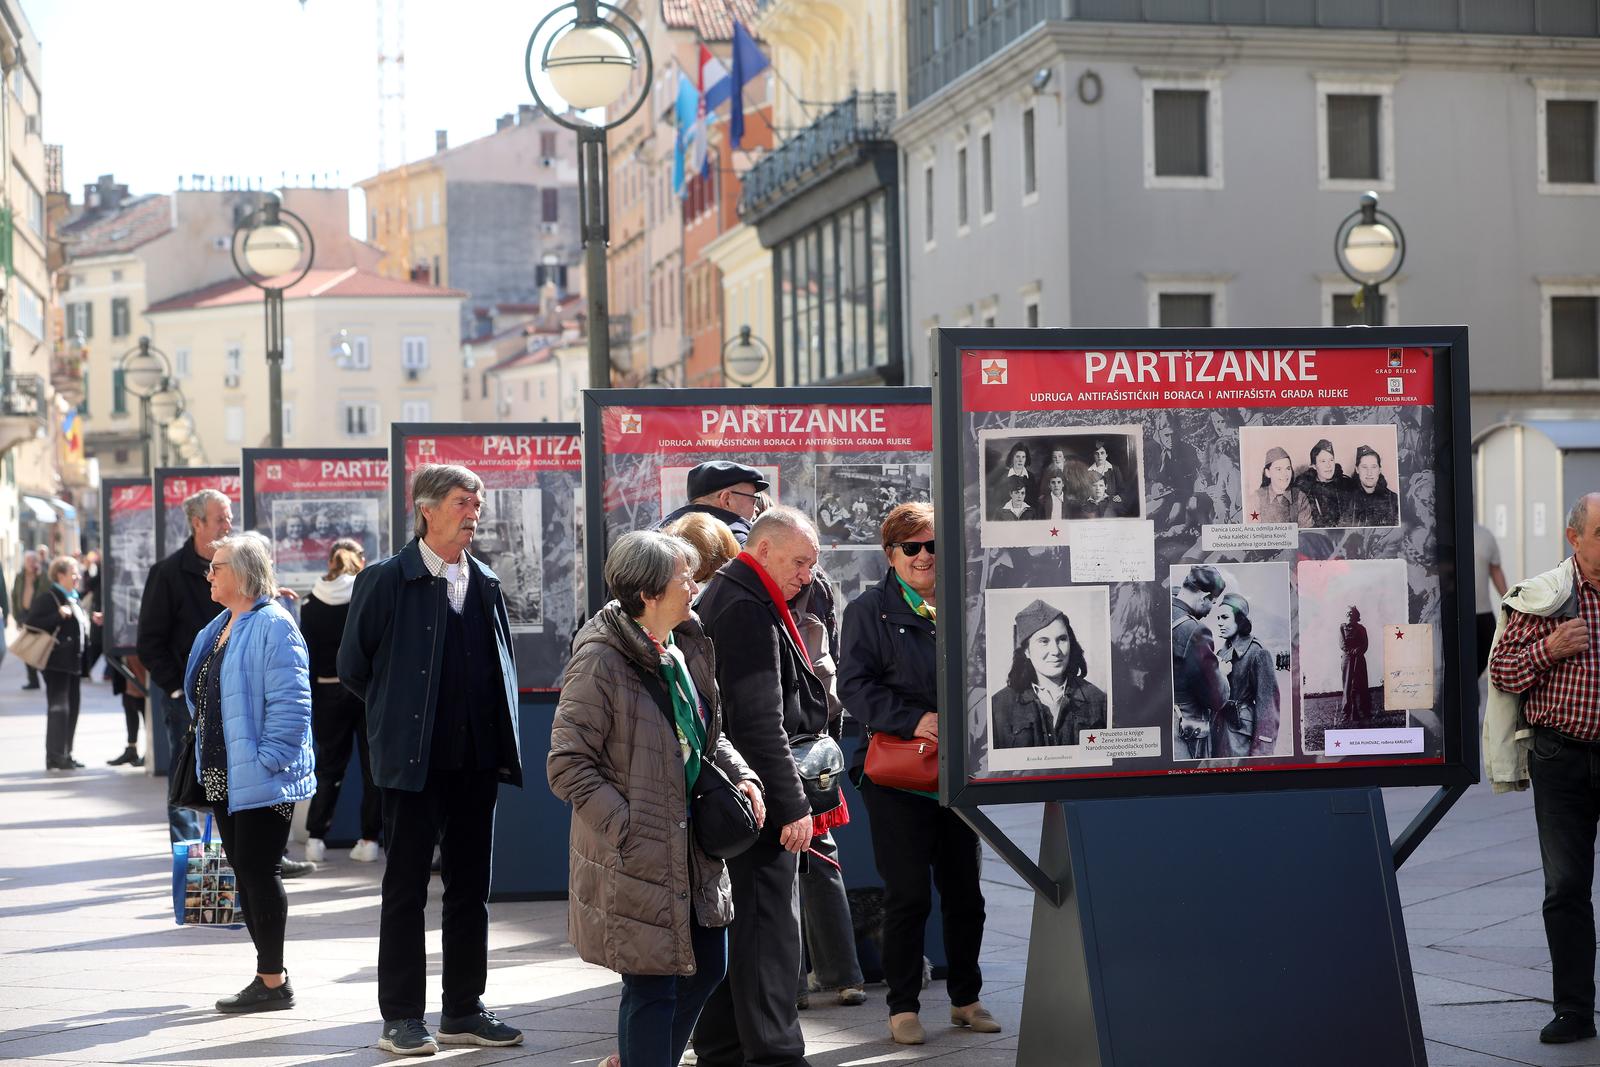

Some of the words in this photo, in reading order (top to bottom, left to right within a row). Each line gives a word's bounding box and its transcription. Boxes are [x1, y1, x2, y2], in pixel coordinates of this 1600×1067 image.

[1030, 392, 1073, 402] UDRUGA
[1077, 389, 1159, 401] ANTIFAŠISTIČKIH
[1164, 390, 1204, 400] BORACA
[1208, 390, 1212, 400] I
[1216, 388, 1277, 400] ANTIFAŠISTA
[1281, 389, 1314, 398] GRADA
[1318, 388, 1349, 398] RIJEKE
[658, 439, 692, 447] UDRUGA
[696, 437, 760, 446] ANTIFAŠISTIČKIH
[805, 437, 854, 446] ANTIFAŠISTA
